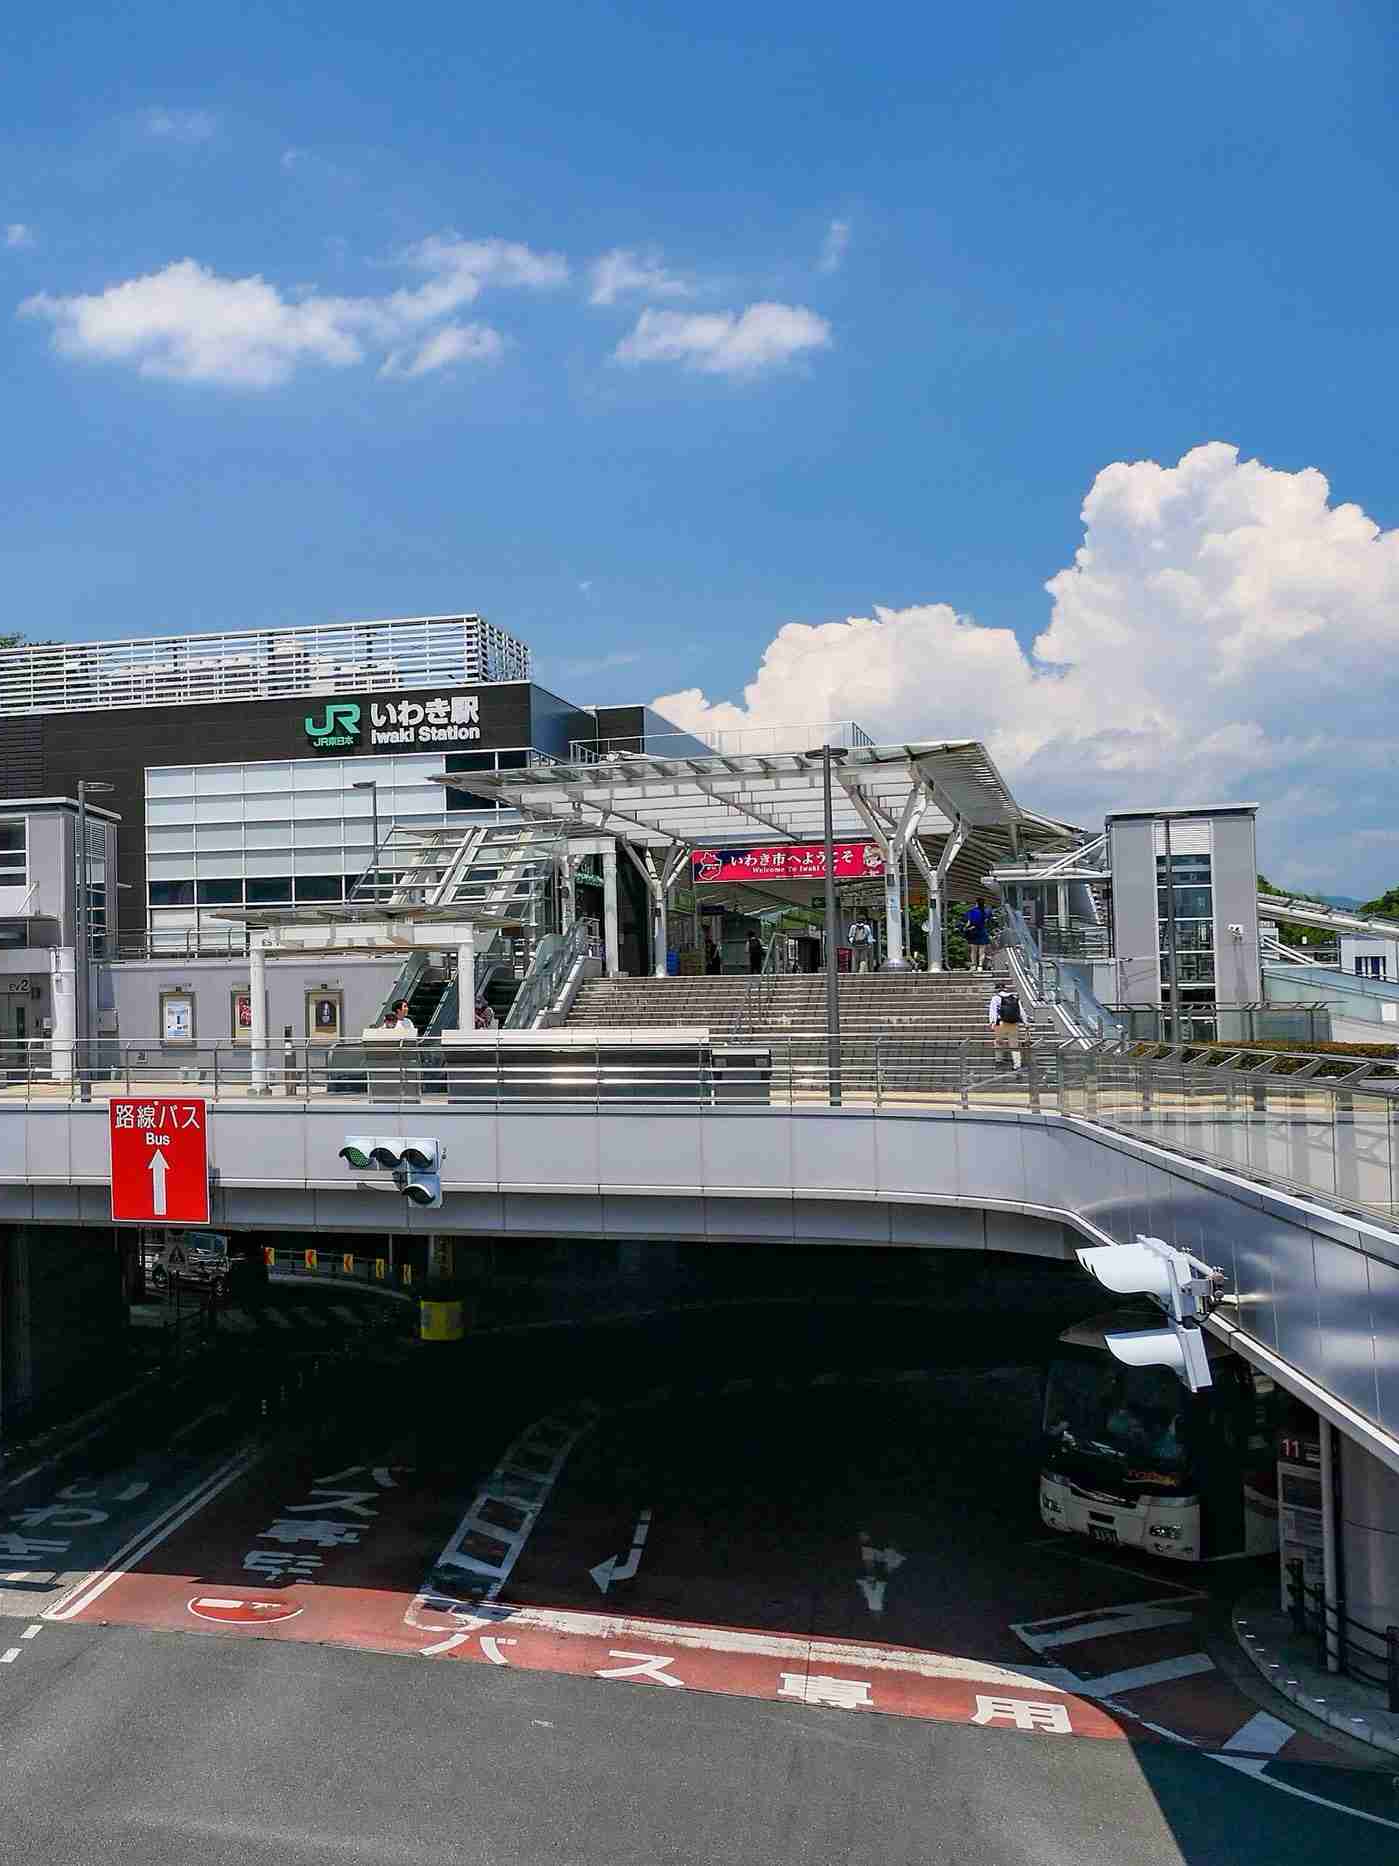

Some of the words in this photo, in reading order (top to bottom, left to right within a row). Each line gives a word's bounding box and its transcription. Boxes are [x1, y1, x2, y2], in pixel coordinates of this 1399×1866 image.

[305, 703, 361, 736] JR
[370, 696, 480, 727] いわき駅
[313, 735, 354, 747] JR東日本
[371, 727, 414, 744] Iwaki
[418, 725, 480, 742] Station
[752, 865, 785, 873] Welcome
[800, 865, 820, 873] Iwaki
[115, 1105, 201, 1130] 路線バス
[145, 1132, 170, 1146] Bus
[418, 1633, 1073, 1736] バス専用
